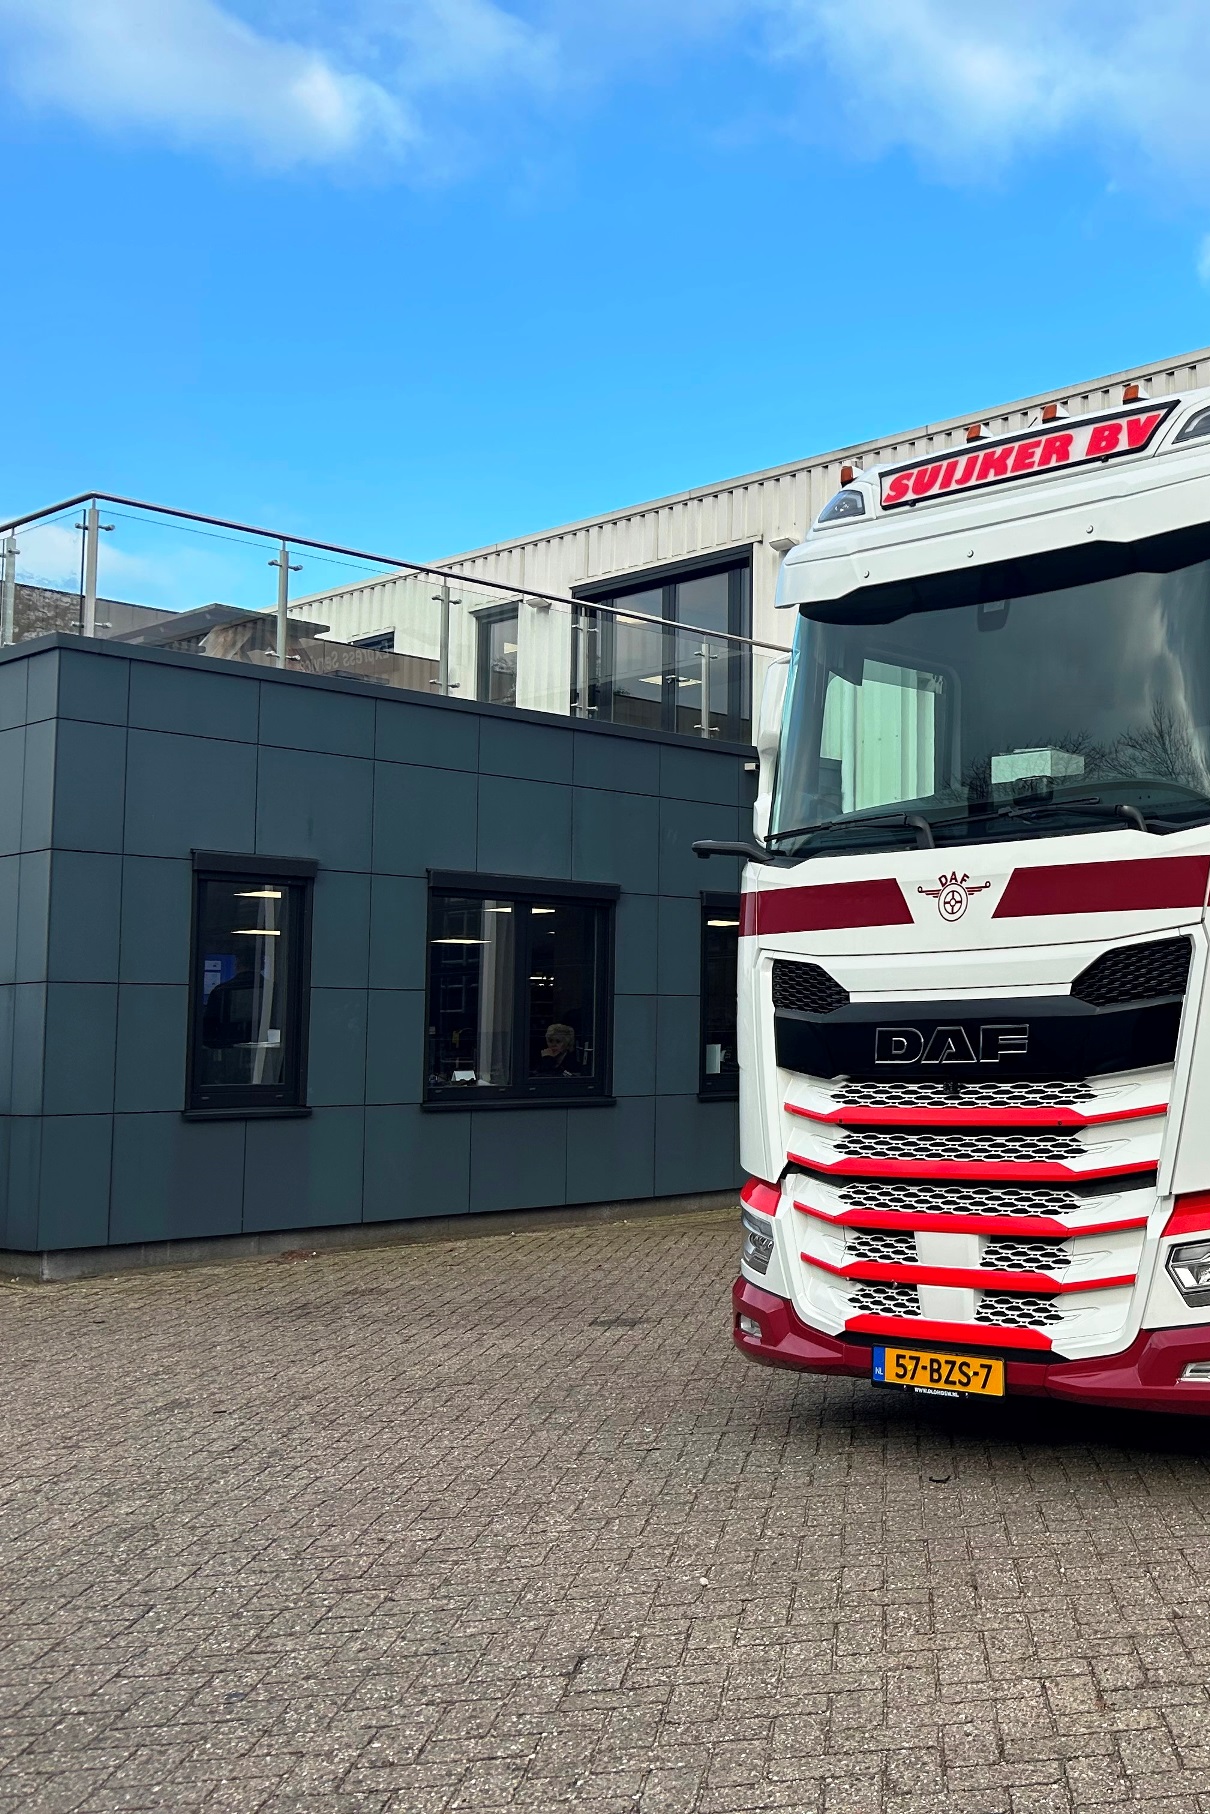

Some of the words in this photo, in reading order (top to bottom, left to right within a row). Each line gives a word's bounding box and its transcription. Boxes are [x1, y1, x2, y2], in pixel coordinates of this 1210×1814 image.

[883, 433, 1074, 504] SUIJKER
[1085, 413, 1161, 457] BV
[938, 871, 970, 887] DAF
[875, 1024, 1029, 1064] DAF
[874, 1366, 884, 1375] NL
[895, 1354, 992, 1389] 57-BZS-7
